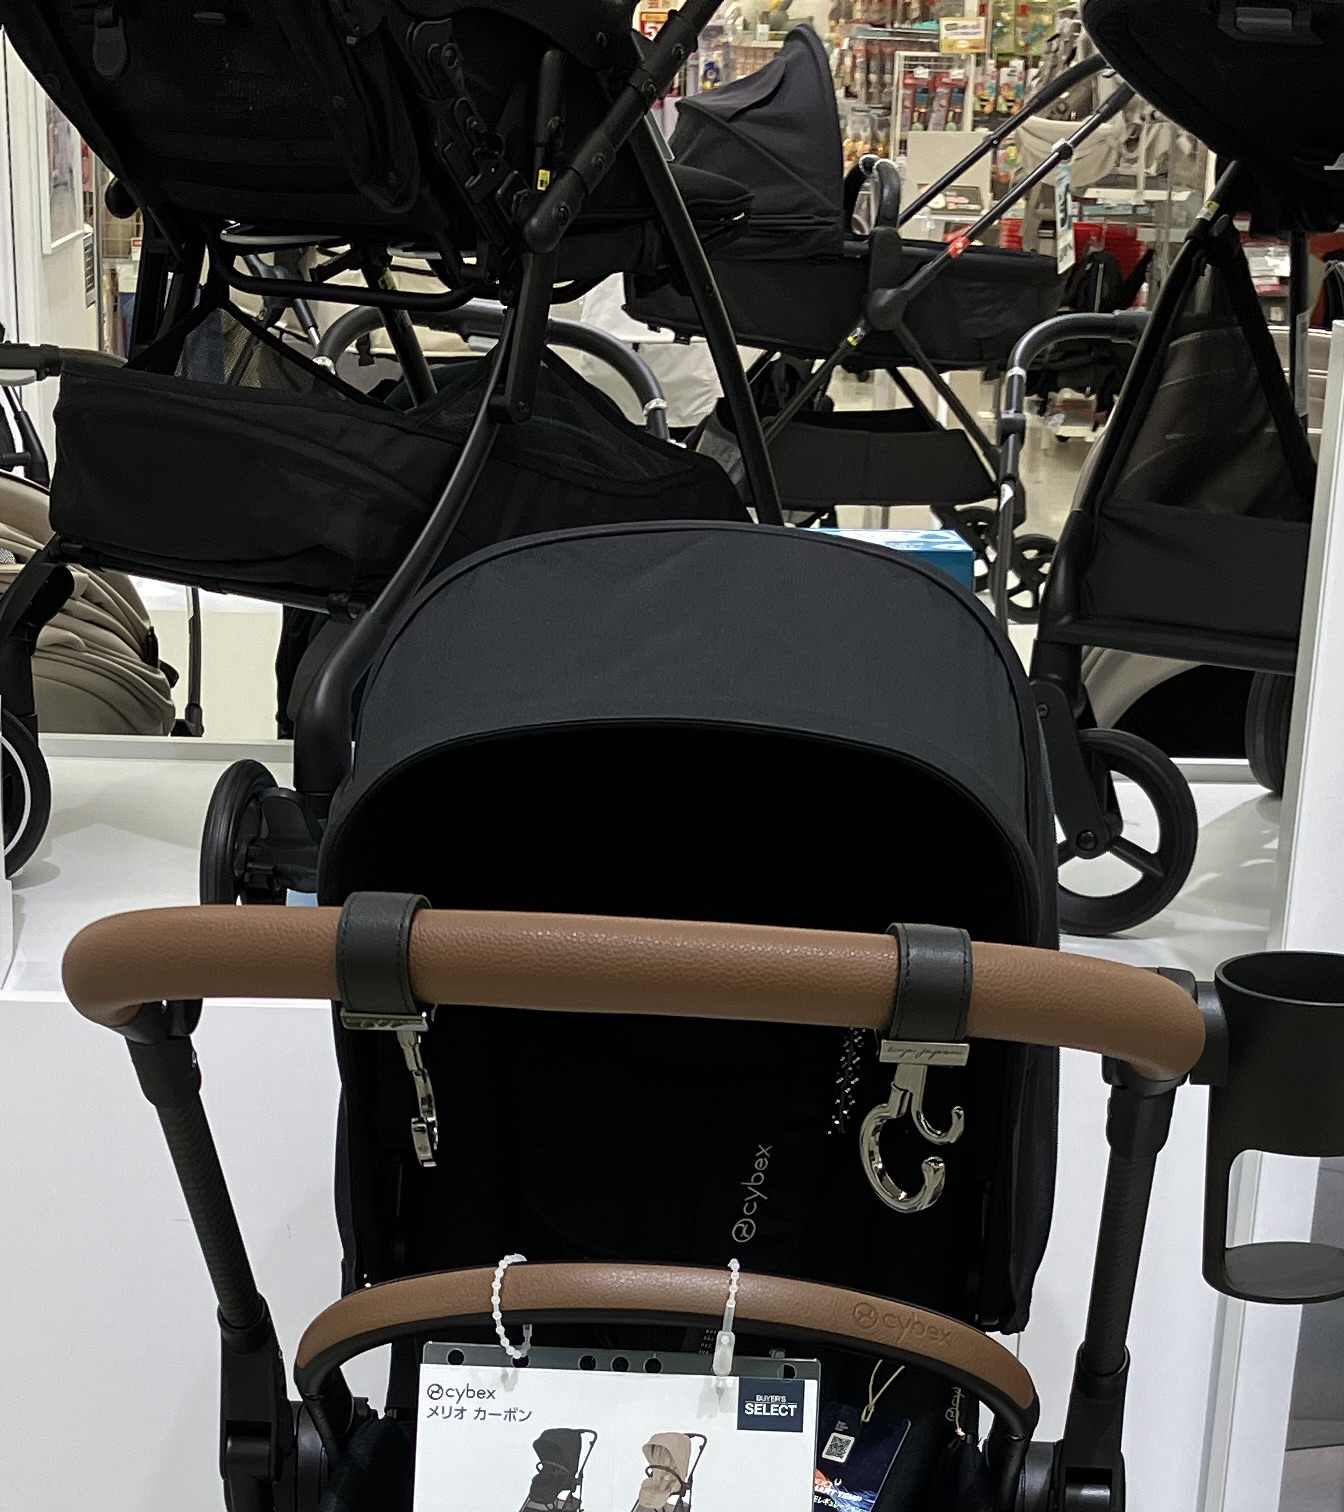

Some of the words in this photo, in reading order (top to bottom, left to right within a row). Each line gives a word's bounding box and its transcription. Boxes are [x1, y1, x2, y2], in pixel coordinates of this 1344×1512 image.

[740, 1144, 774, 1216] cybex
[881, 1312, 954, 1348] cybex
[445, 1383, 497, 1404] cybex
[426, 1405, 468, 1421] メリオ
[472, 1406, 533, 1423] カーボン
[744, 1403, 798, 1417] SELECT
